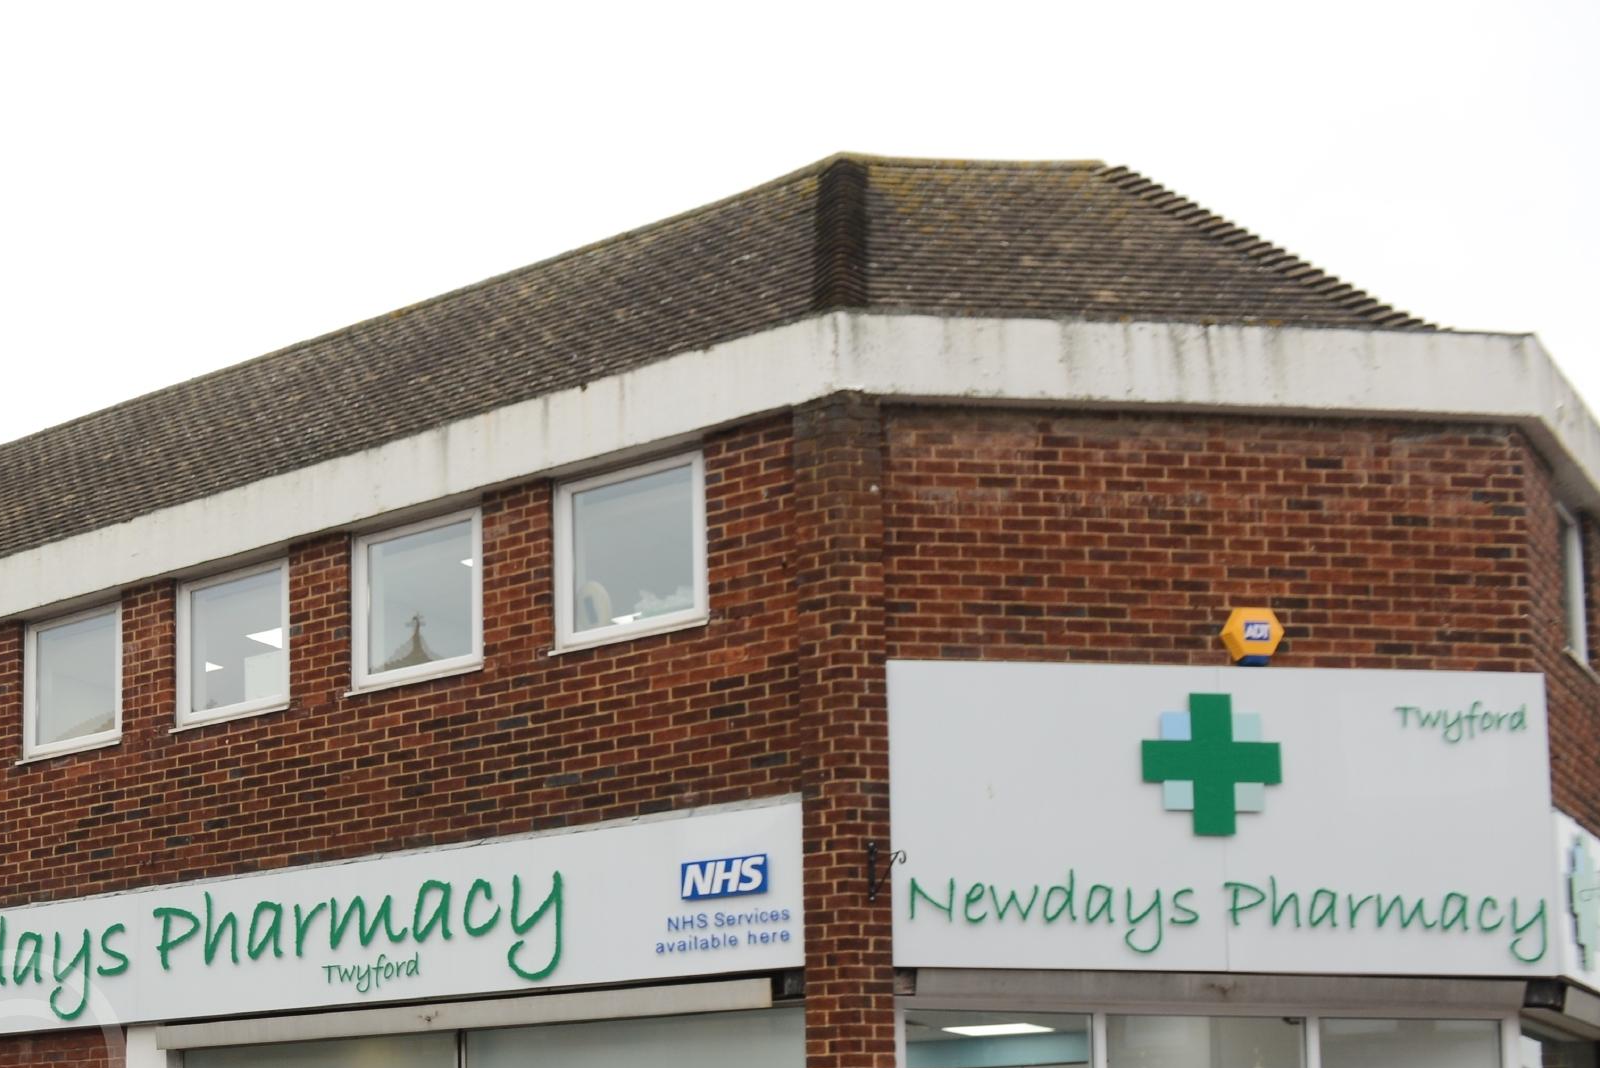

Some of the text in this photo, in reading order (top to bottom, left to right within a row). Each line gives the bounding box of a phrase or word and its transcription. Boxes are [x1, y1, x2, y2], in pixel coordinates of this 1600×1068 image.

[1244, 624, 1270, 639] ADT
[1395, 701, 1527, 742] Twyford
[682, 856, 765, 897] NHS
[153, 870, 563, 981] Pharmacy
[667, 908, 791, 932] NHS Services
[909, 869, 1547, 963] Newdays Pharmacy
[655, 929, 791, 954] available here
[321, 952, 420, 992] Twyford
